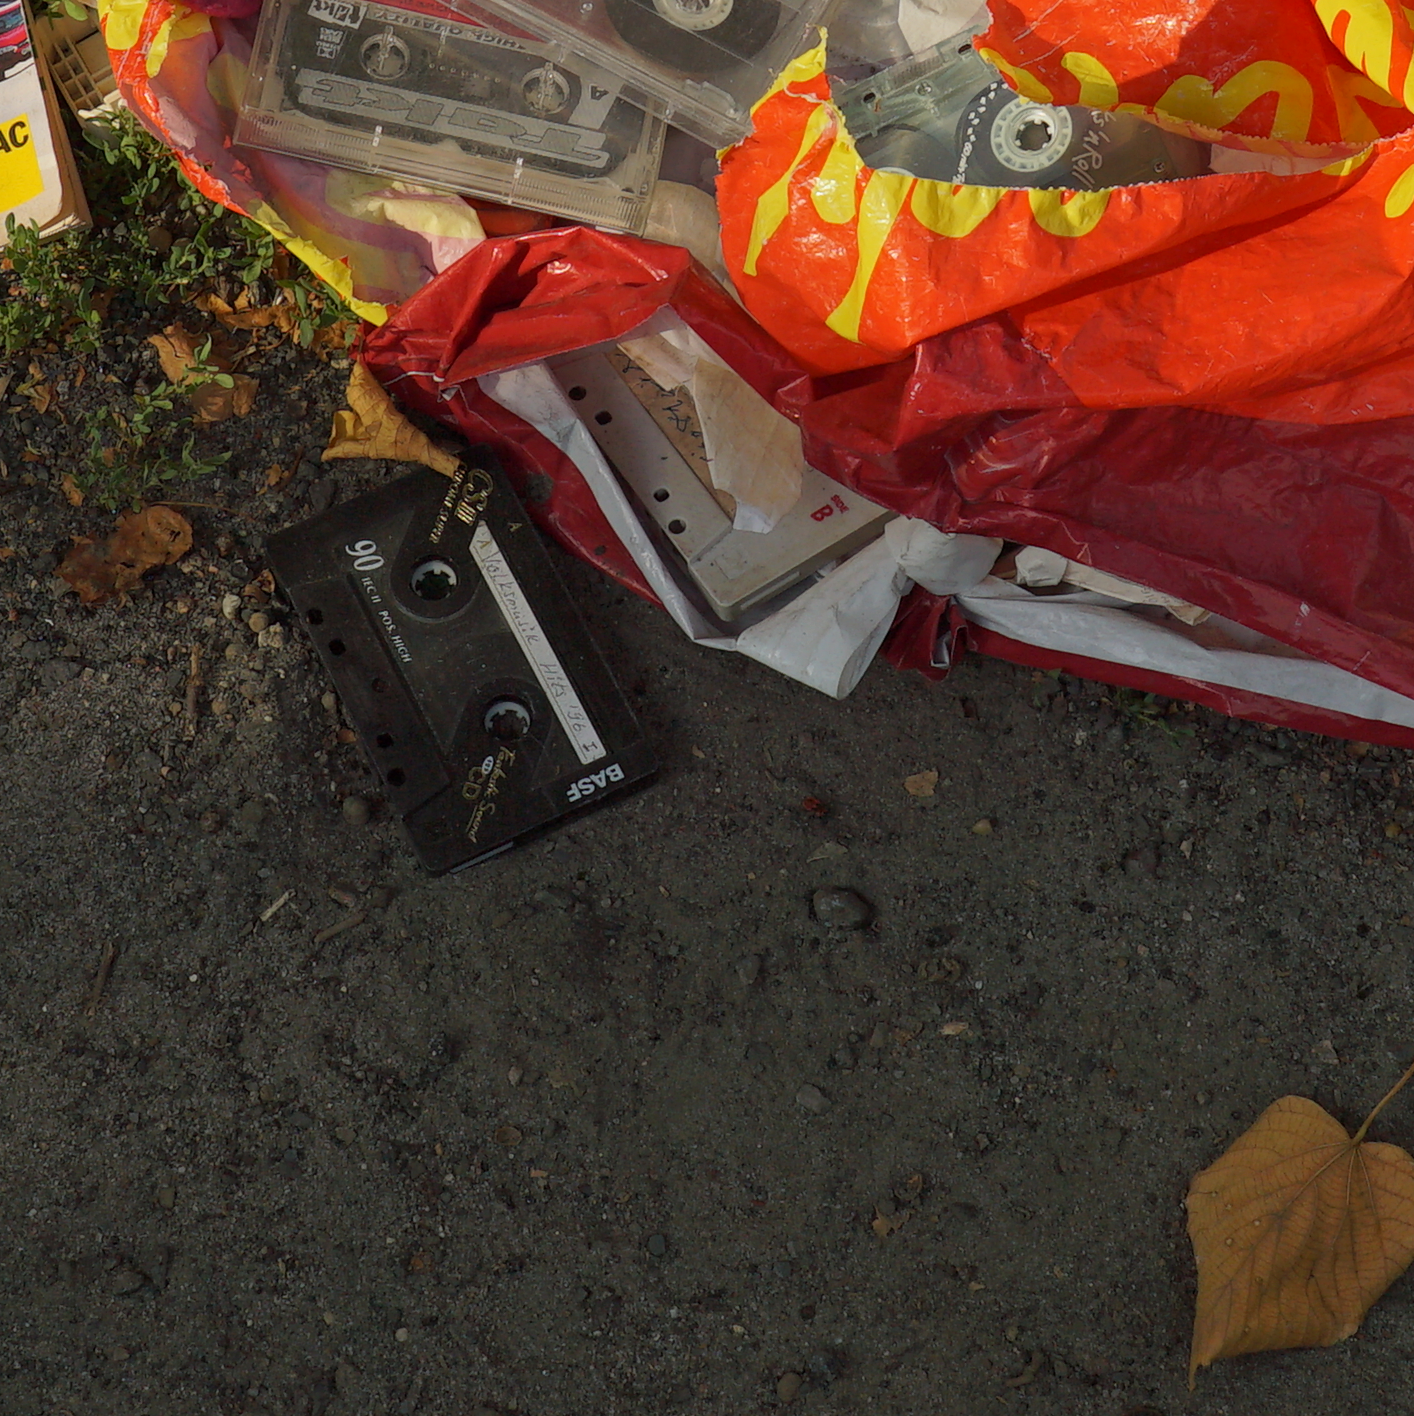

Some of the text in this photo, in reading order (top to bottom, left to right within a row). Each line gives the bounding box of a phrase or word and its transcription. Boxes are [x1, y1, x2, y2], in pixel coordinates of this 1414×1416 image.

[343, 532, 384, 578] 90
[360, 575, 412, 665] IEC II POS. HIGH
[567, 764, 624, 803] BASF
